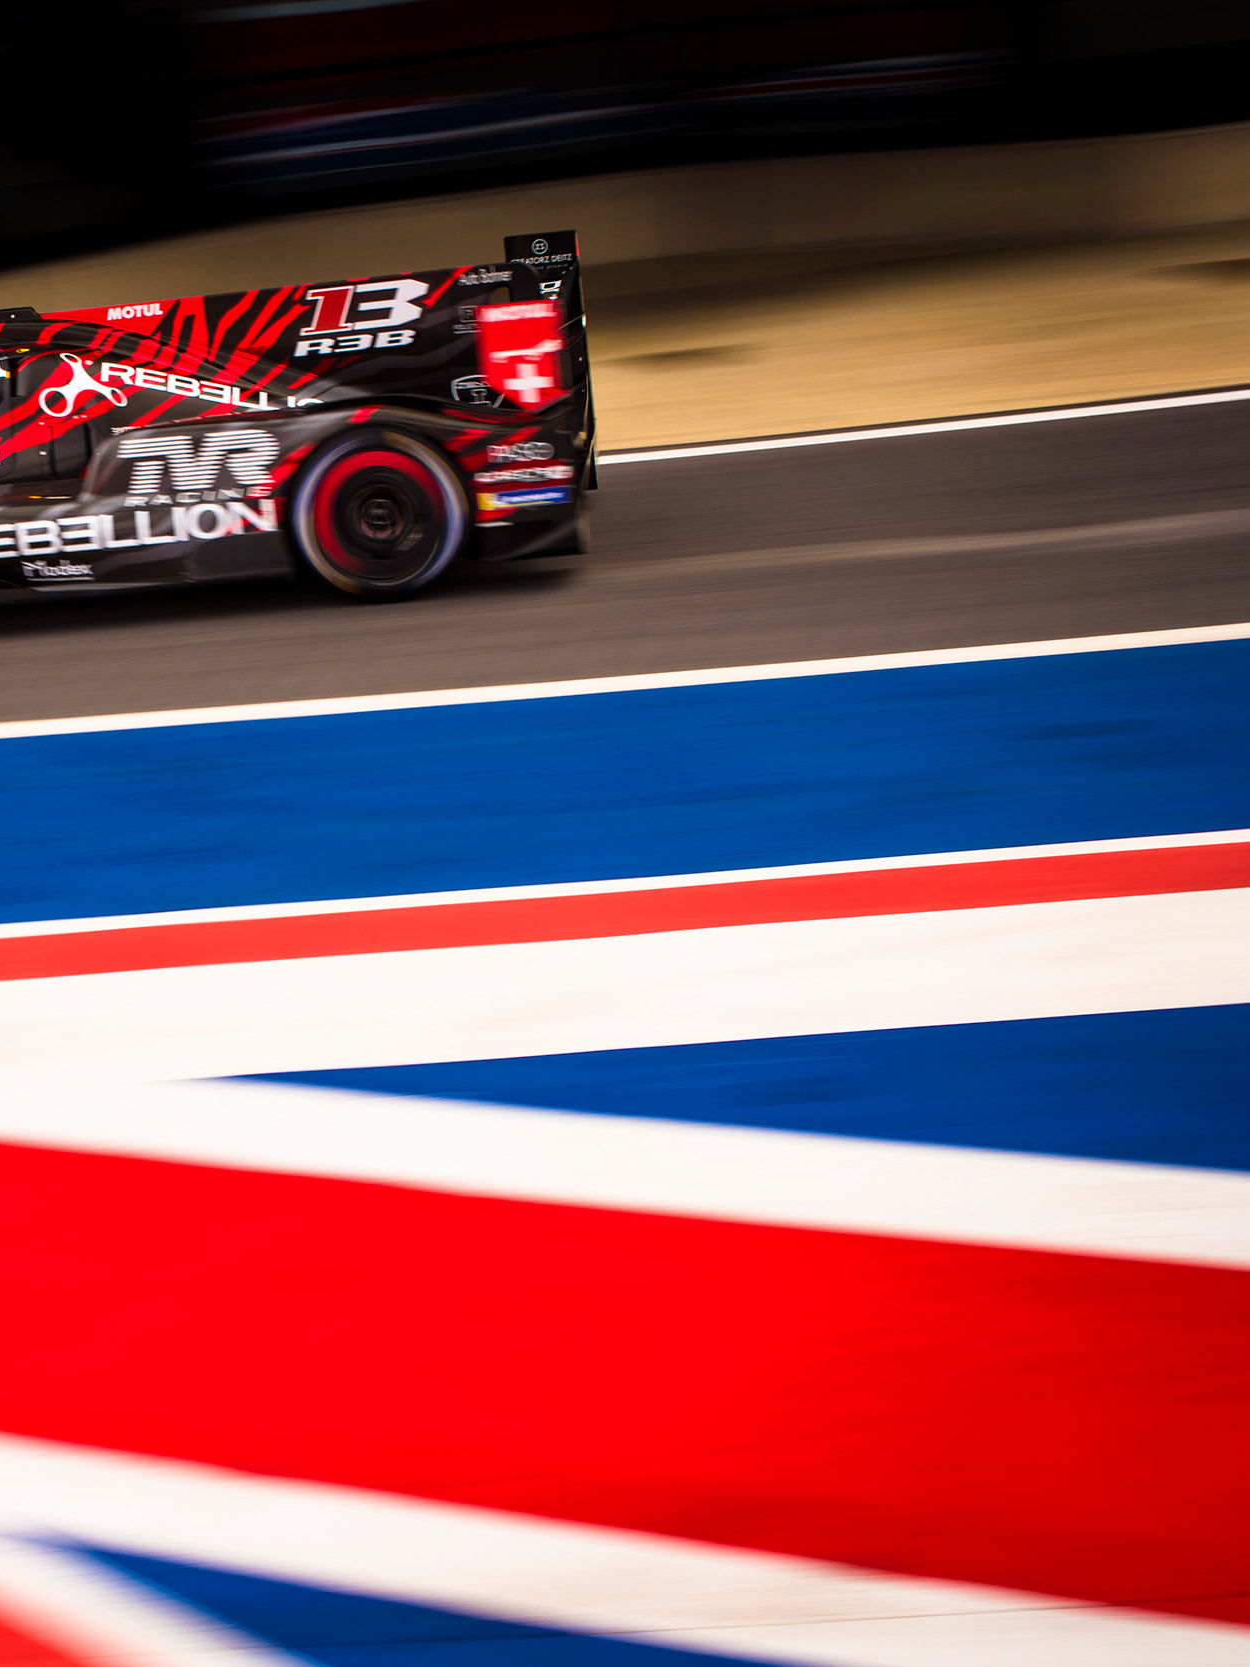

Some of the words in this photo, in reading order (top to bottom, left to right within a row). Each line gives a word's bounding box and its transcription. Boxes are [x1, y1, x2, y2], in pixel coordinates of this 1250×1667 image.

[107, 304, 163, 321] MOTUL
[116, 428, 281, 494] TVR
[123, 485, 275, 507] RACING
